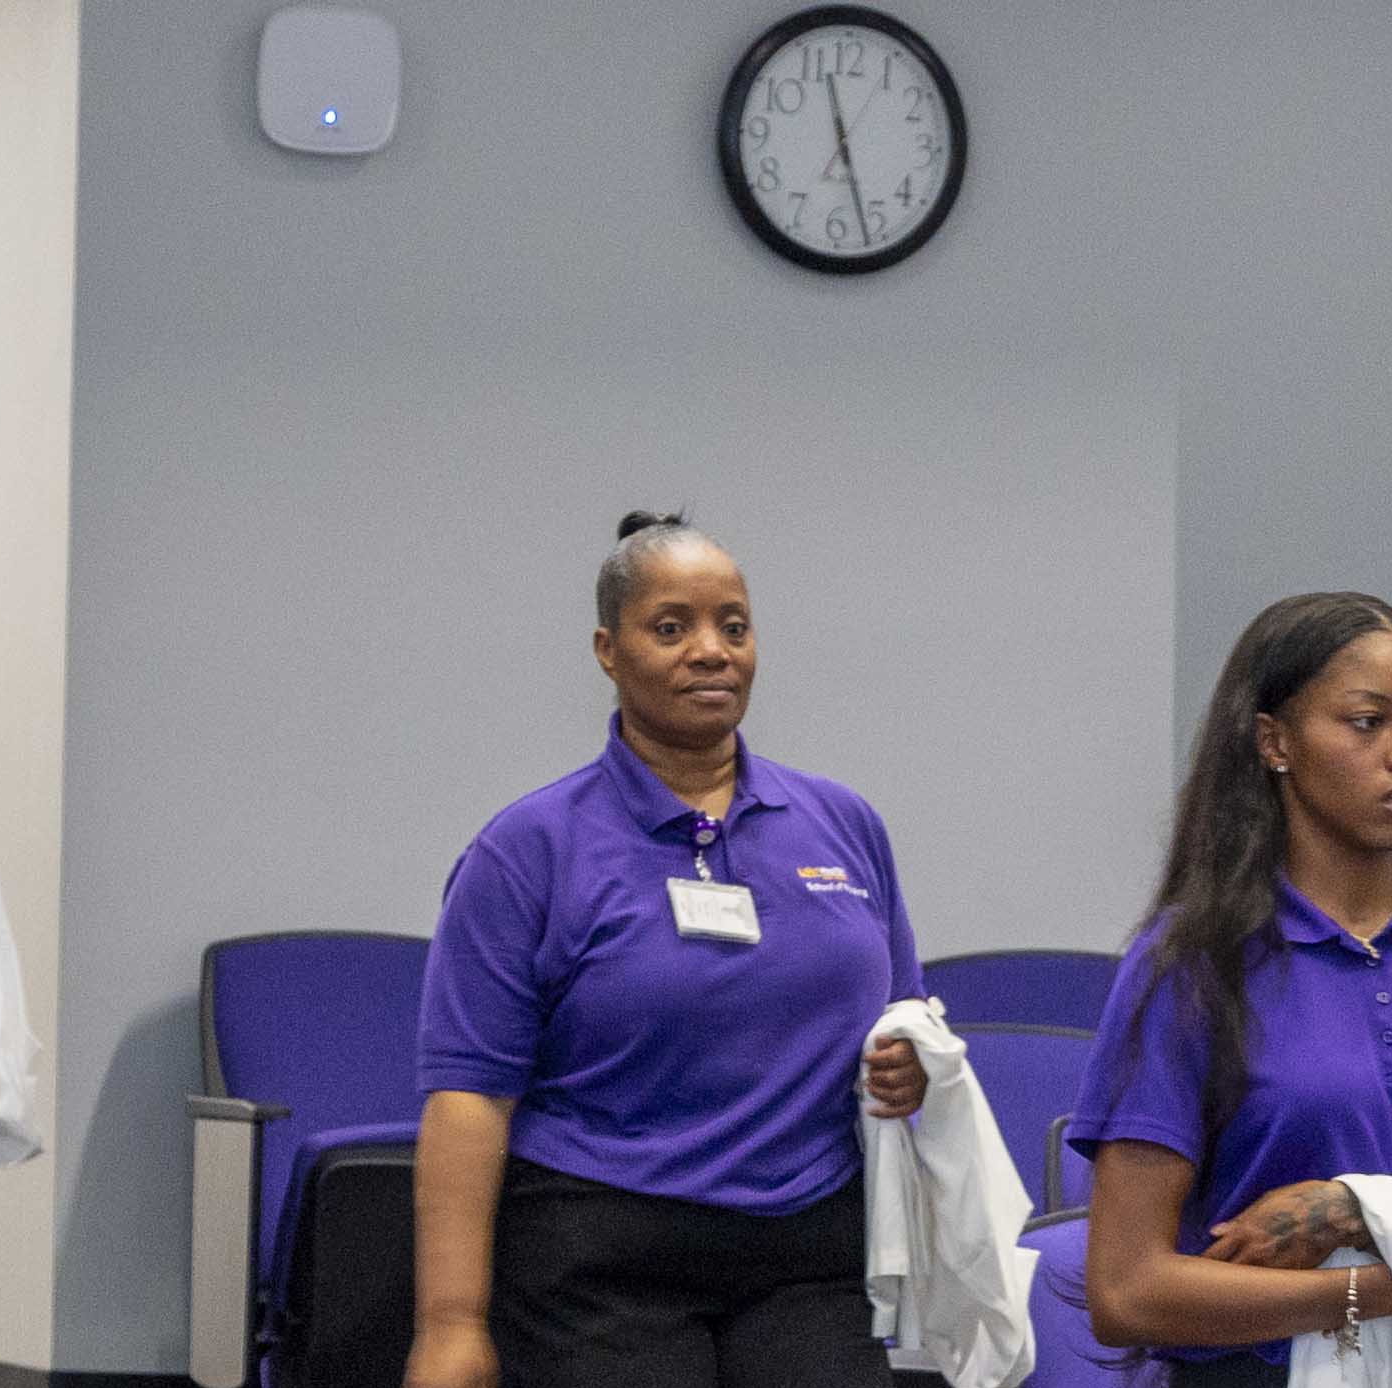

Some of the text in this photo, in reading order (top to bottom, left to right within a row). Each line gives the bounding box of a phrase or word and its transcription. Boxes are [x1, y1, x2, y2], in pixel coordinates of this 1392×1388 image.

[800, 46, 826, 82] 11
[835, 41, 864, 76] 12
[881, 54, 892, 91] 1
[767, 75, 804, 114] 10
[904, 86, 922, 122] 2
[747, 115, 770, 150] 9
[914, 133, 934, 168] 3
[757, 156, 780, 192] 8
[894, 174, 913, 207] 4
[785, 191, 809, 230] 7
[825, 205, 848, 240] 6
[867, 200, 886, 236] 5
